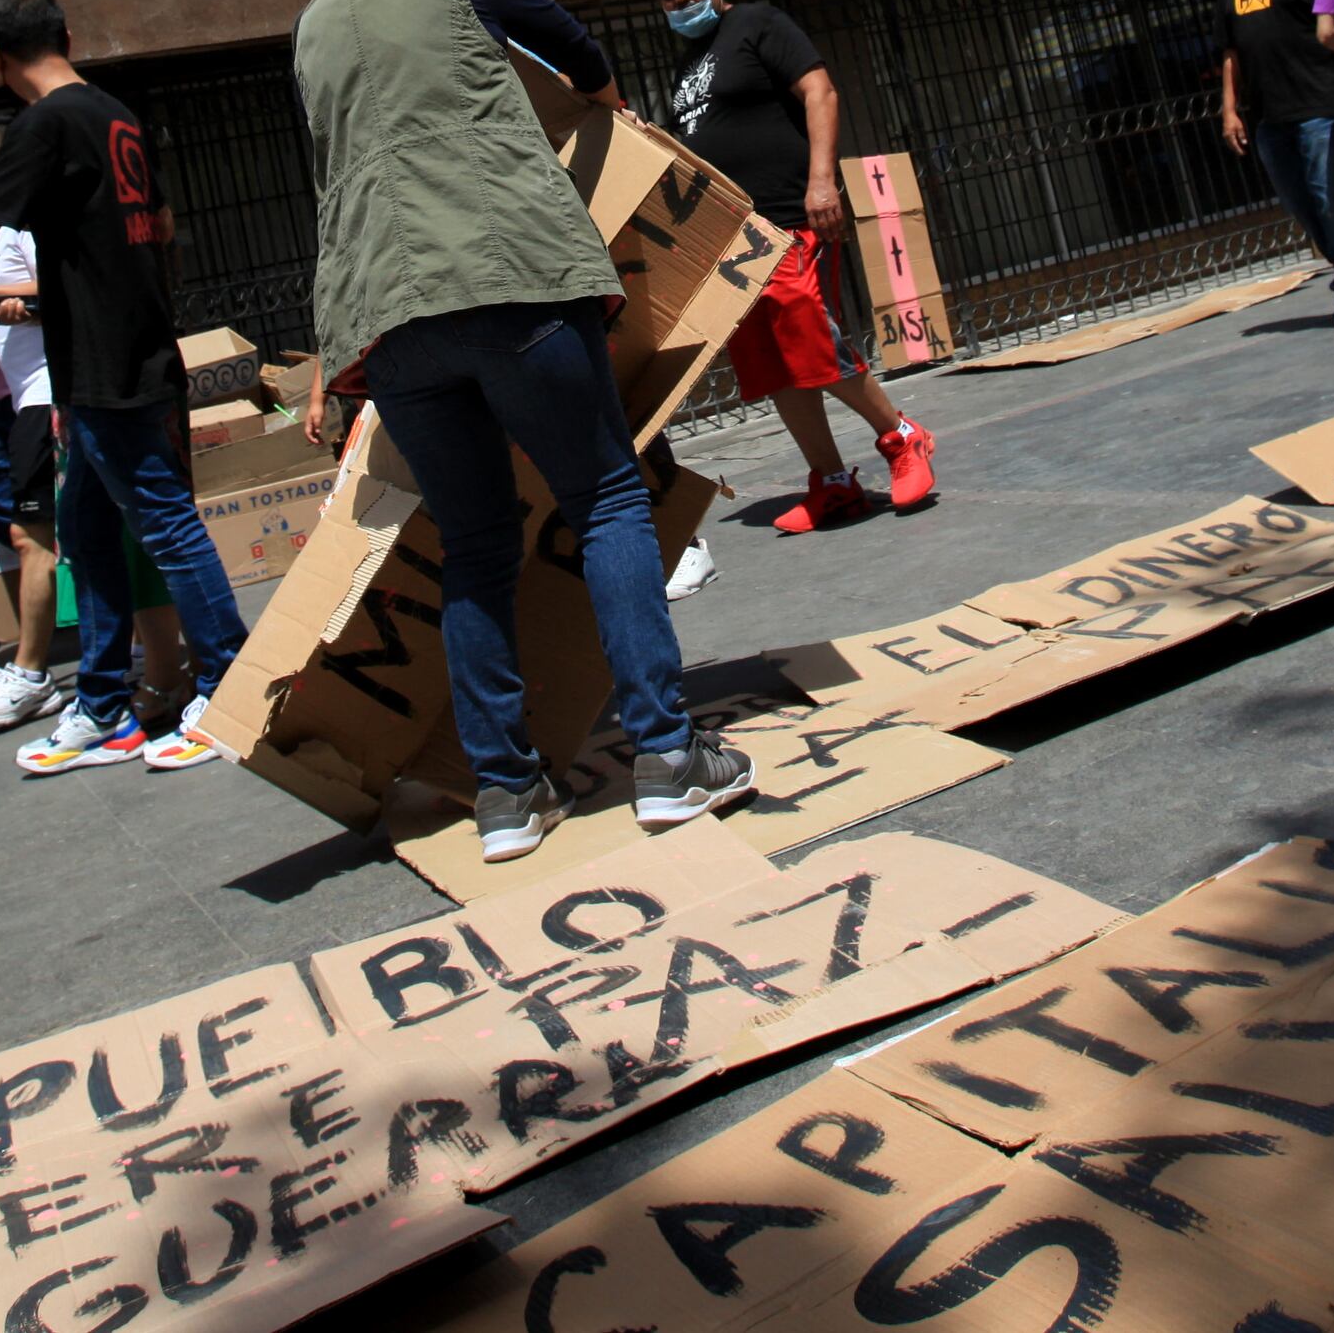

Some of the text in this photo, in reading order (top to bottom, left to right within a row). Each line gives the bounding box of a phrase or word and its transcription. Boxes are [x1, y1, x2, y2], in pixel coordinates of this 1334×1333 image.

[680, 103, 709, 124] ARIAT
[204, 478, 333, 519] PAN TOSTADO
[872, 620, 1024, 676] EL
[1057, 505, 1308, 609] DINERO
[507, 870, 1042, 1067] PAZ
